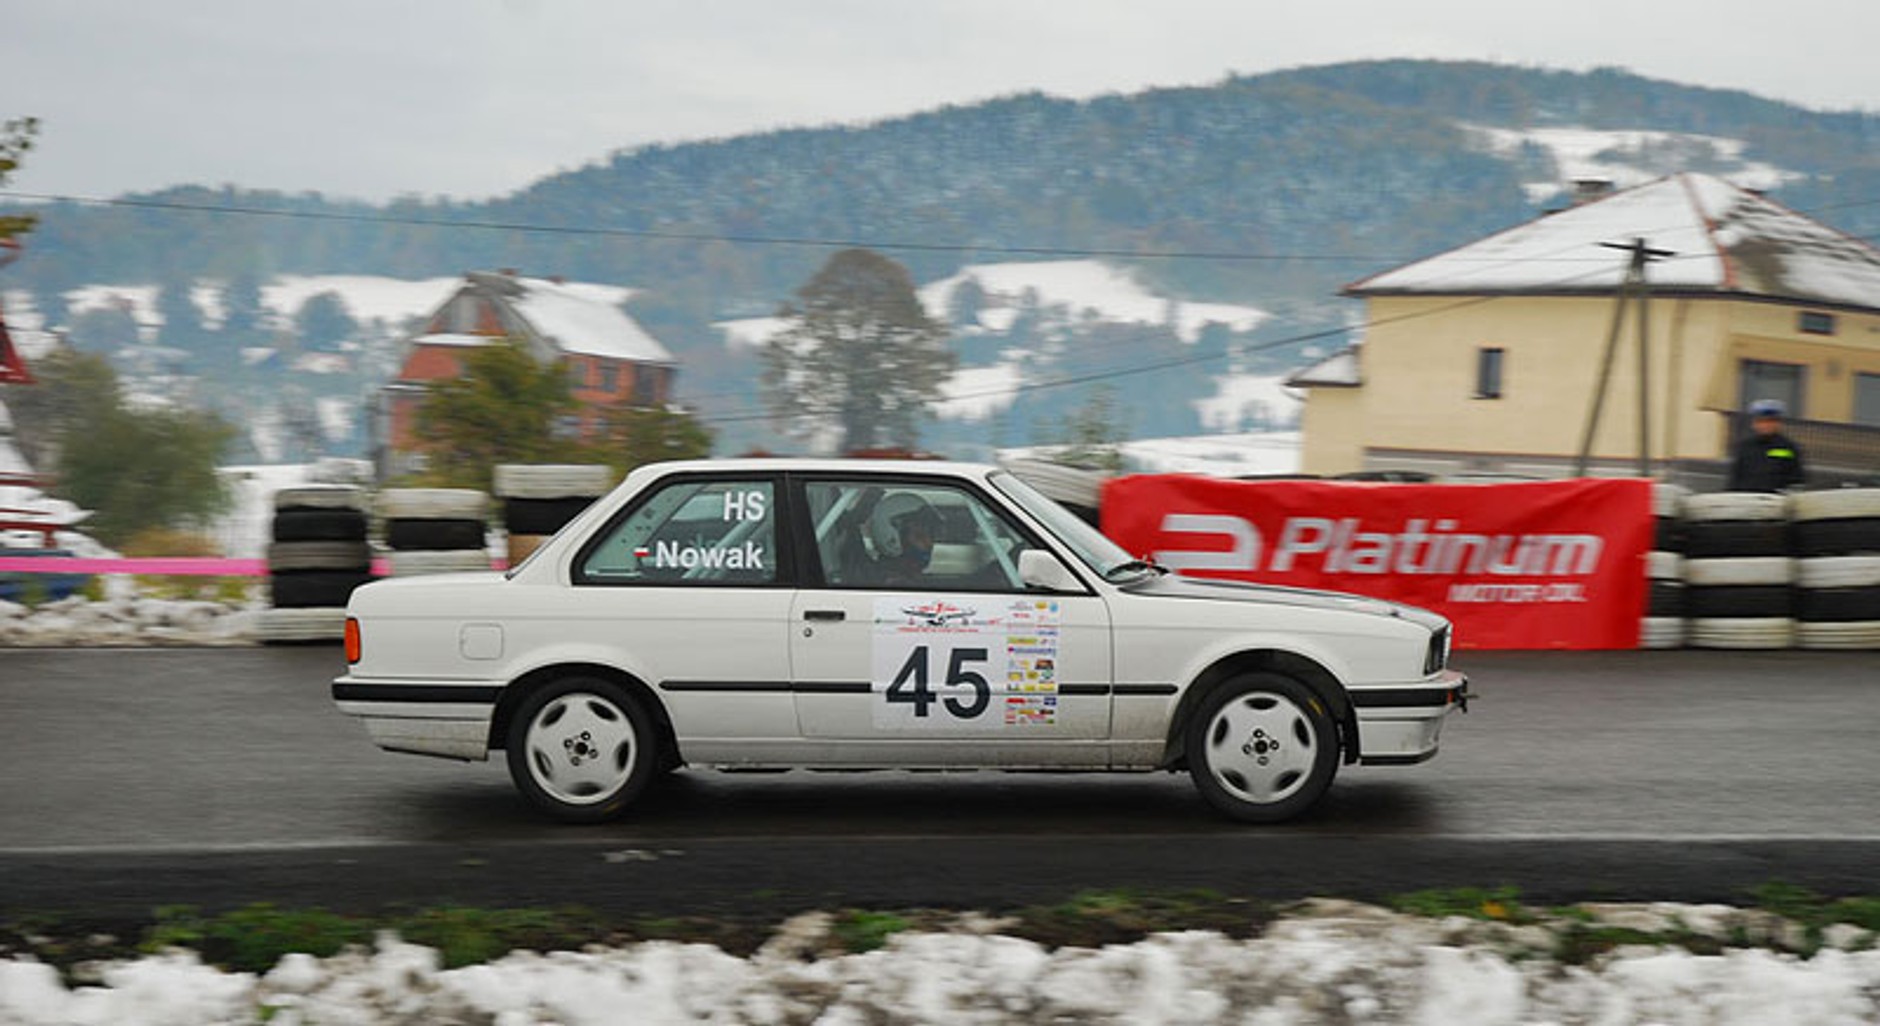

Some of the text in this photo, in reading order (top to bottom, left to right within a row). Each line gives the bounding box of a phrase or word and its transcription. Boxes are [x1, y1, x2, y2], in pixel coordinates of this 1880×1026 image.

[723, 491, 765, 521] HS
[655, 540, 763, 569] Nowak
[1271, 517, 1603, 575] Platinum
[1449, 583, 1542, 602] MOTOR
[886, 645, 991, 719] 45
